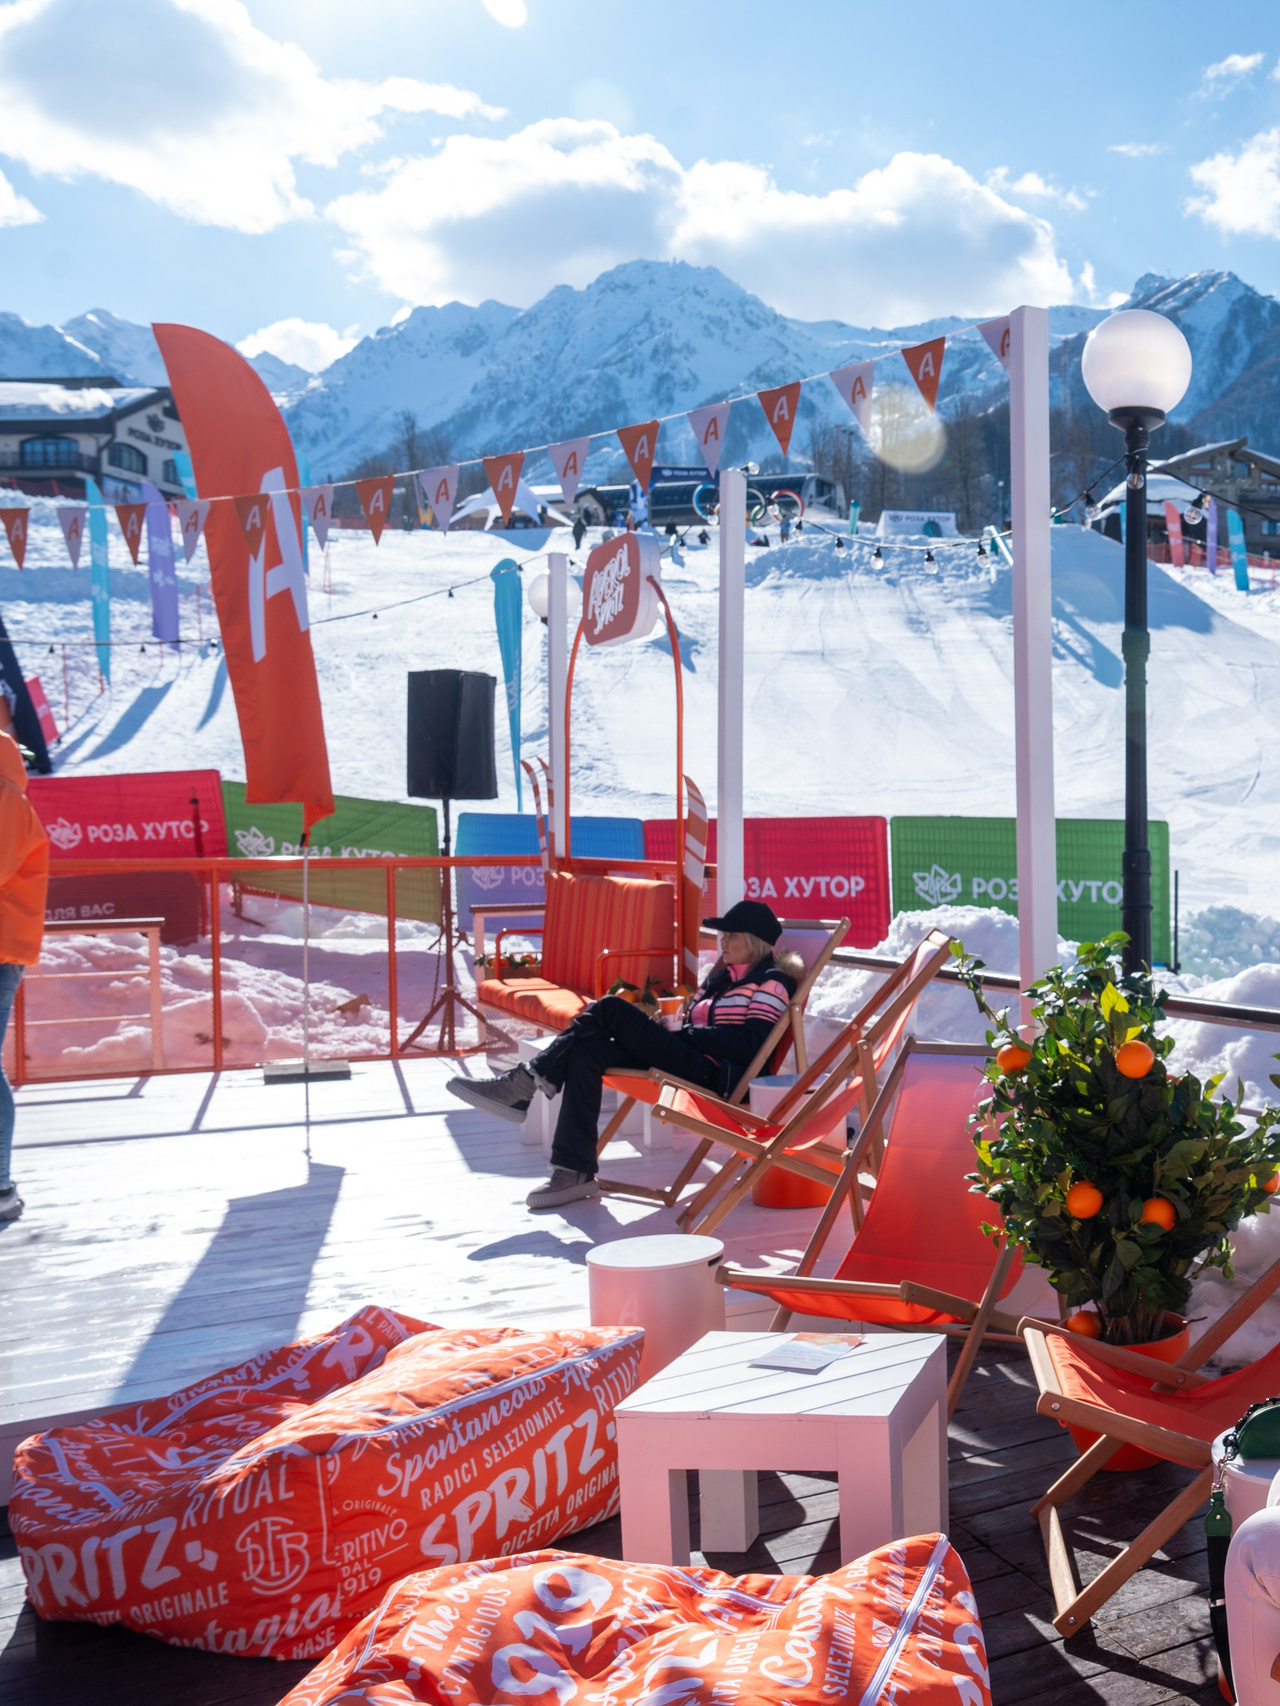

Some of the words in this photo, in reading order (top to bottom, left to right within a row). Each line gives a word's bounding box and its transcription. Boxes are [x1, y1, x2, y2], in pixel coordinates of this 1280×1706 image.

[248, 466, 310, 664] A
[86, 823, 139, 843] РОЗА
[80, 902, 115, 918] ВАС
[784, 875, 866, 898] ХУТОР
[378, 1376, 547, 1499] Spontaneous
[420, 1461, 478, 1510] RADICI
[483, 1396, 566, 1469] SELEZIONATE
[342, 1499, 398, 1518] ORIGINALE
[420, 1408, 605, 1567] SPRITZ
[501, 1508, 560, 1557] RICETTA
[566, 1458, 621, 1512] ORIGINA
[20, 1516, 182, 1608] PRITZ
[341, 1558, 372, 1578] DAL
[130, 1581, 229, 1625] ORIGINALE
[402, 1604, 461, 1652] The
[436, 1587, 513, 1696] CONTAGIOUS
